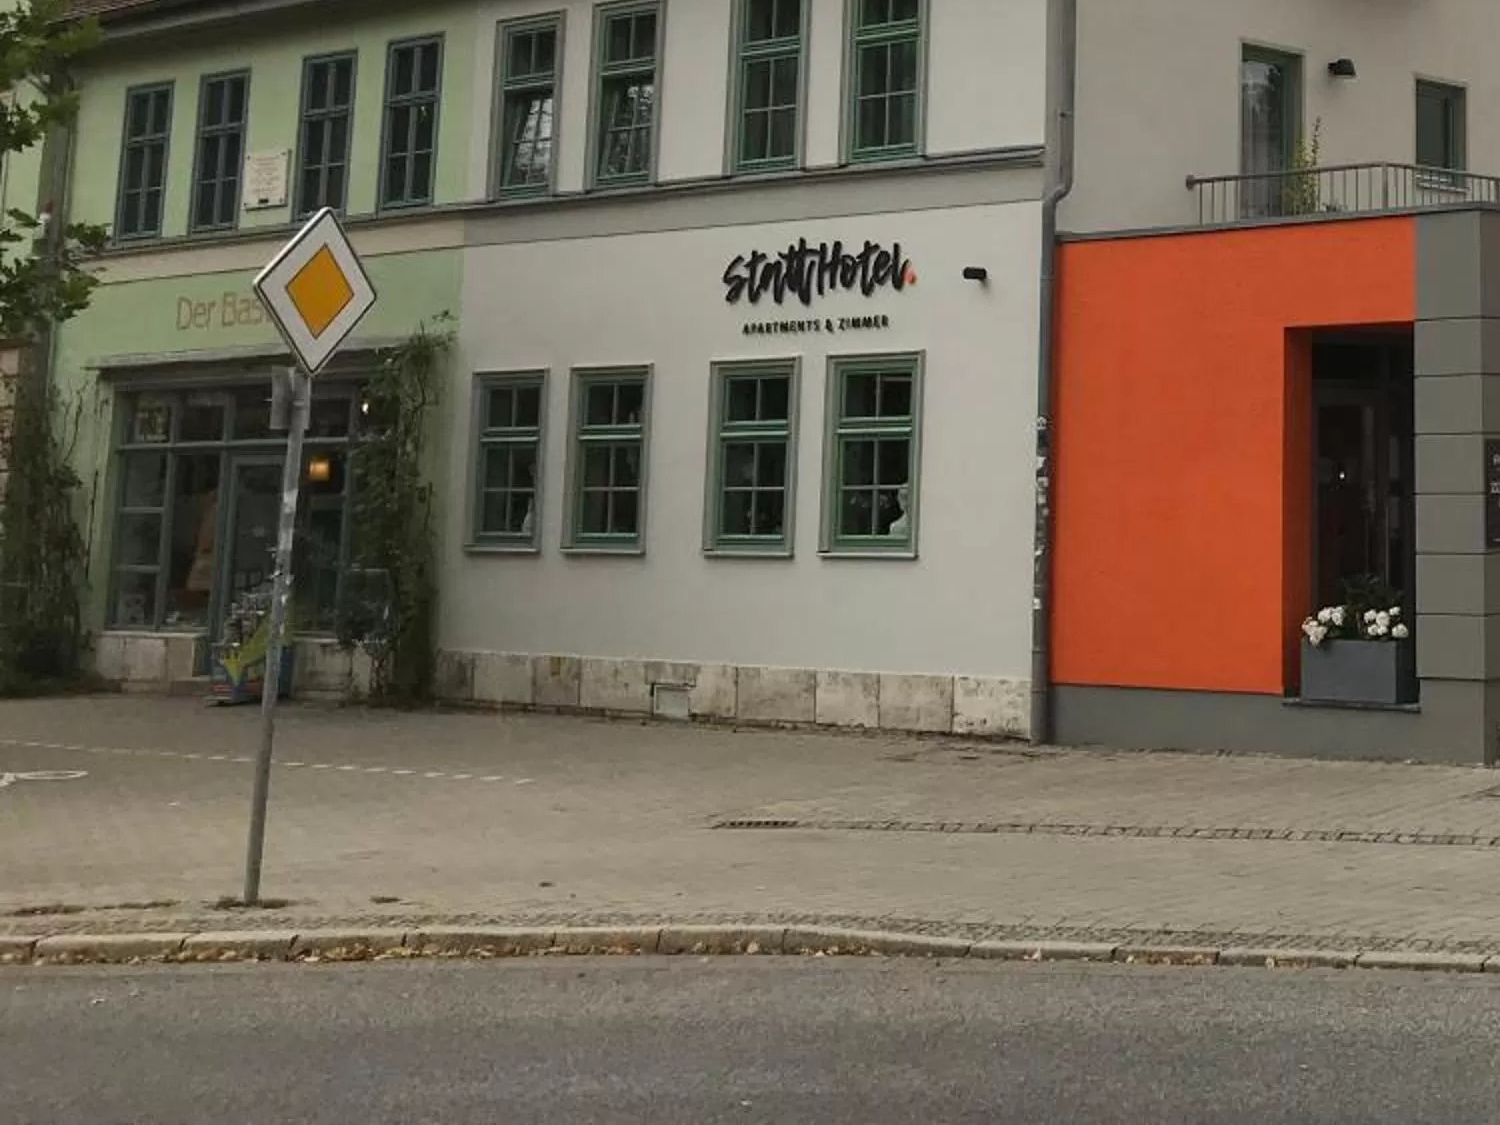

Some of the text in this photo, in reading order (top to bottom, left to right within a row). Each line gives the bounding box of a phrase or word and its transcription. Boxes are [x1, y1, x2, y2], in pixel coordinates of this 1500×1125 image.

[176, 296, 216, 330] Der
[742, 315, 889, 335] APARTMENTS & ZIMMER
